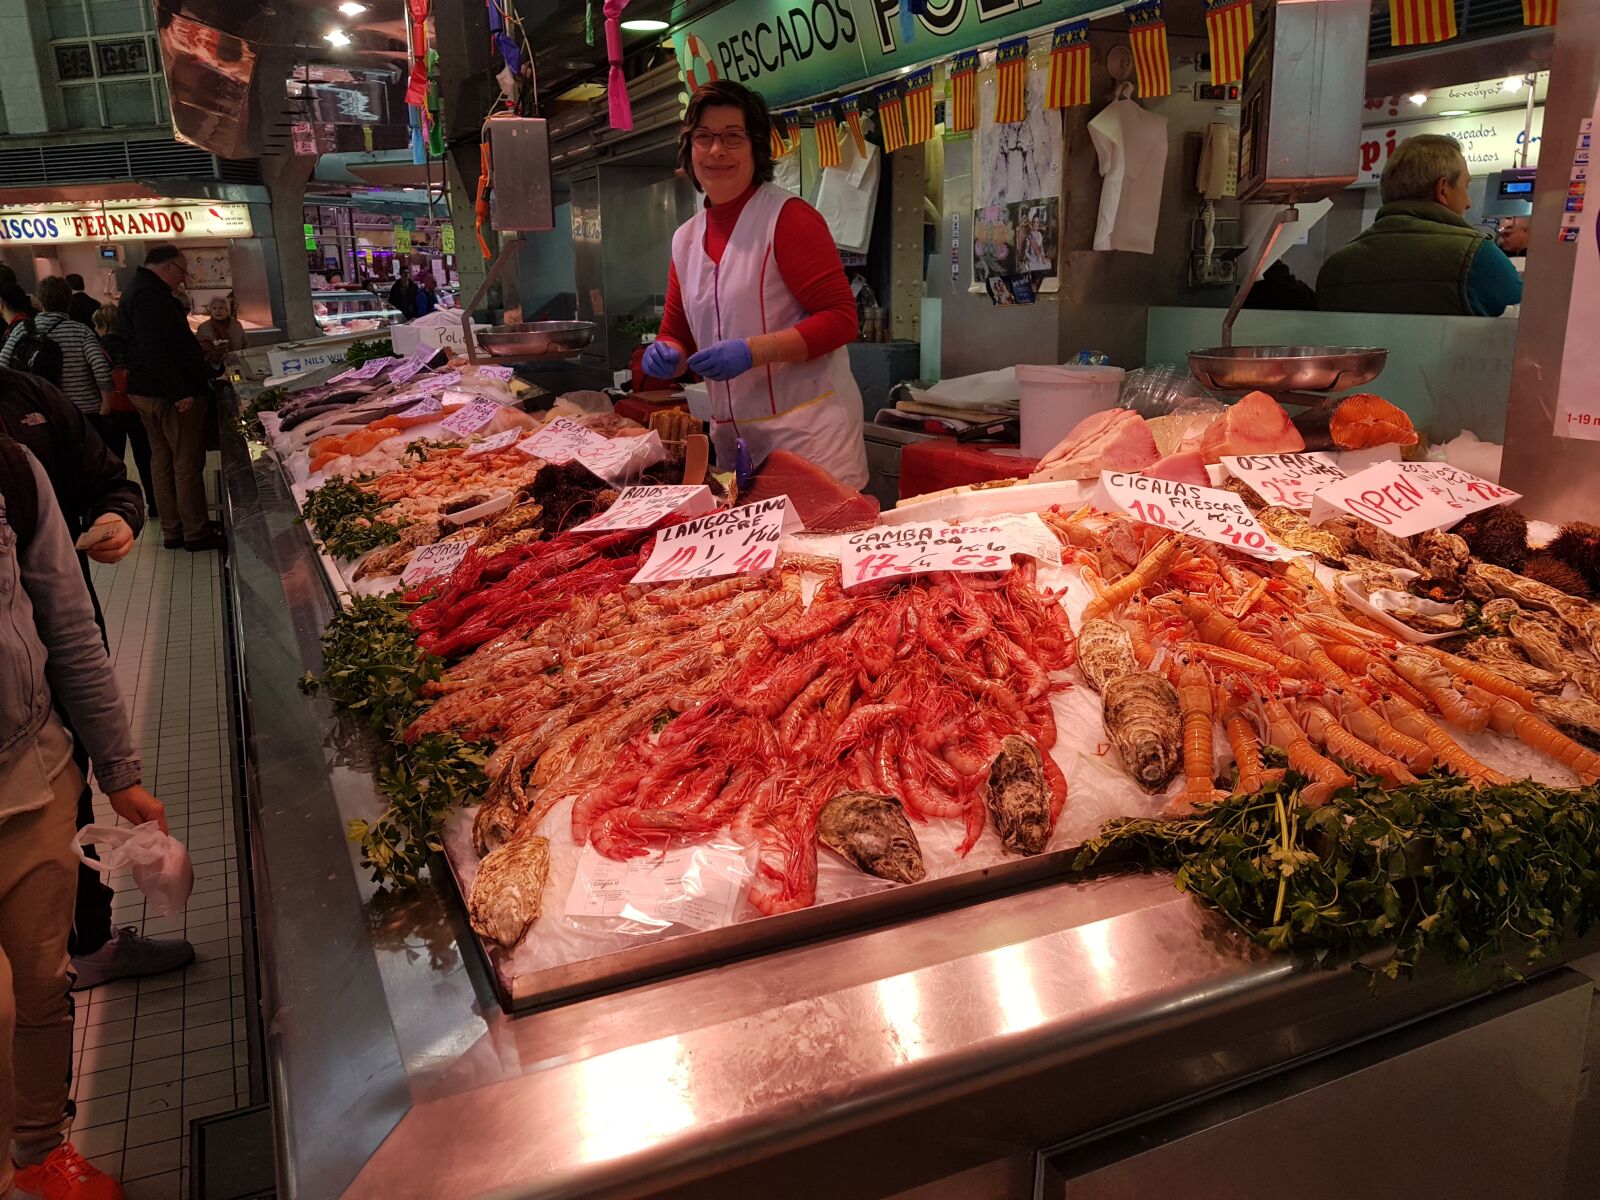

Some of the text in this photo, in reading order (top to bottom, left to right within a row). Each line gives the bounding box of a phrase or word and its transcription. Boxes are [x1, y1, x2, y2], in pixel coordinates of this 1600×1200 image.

[716, 0, 857, 82] PESCADOS
[0, 216, 59, 239] ISCOS
[304, 356, 325, 366] NILS
[555, 419, 592, 437] COLAS
[1568, 413, 1591, 425] 1-19
[622, 486, 666, 500] ROJOS
[1110, 474, 1200, 499] CIGALAS
[1169, 497, 1244, 514] FRESCAS
[1344, 474, 1424, 525] OPEN
[702, 515, 765, 540] TIGRE
[849, 527, 1003, 545] GAMBA FRESCA
[951, 554, 1002, 567] 68
